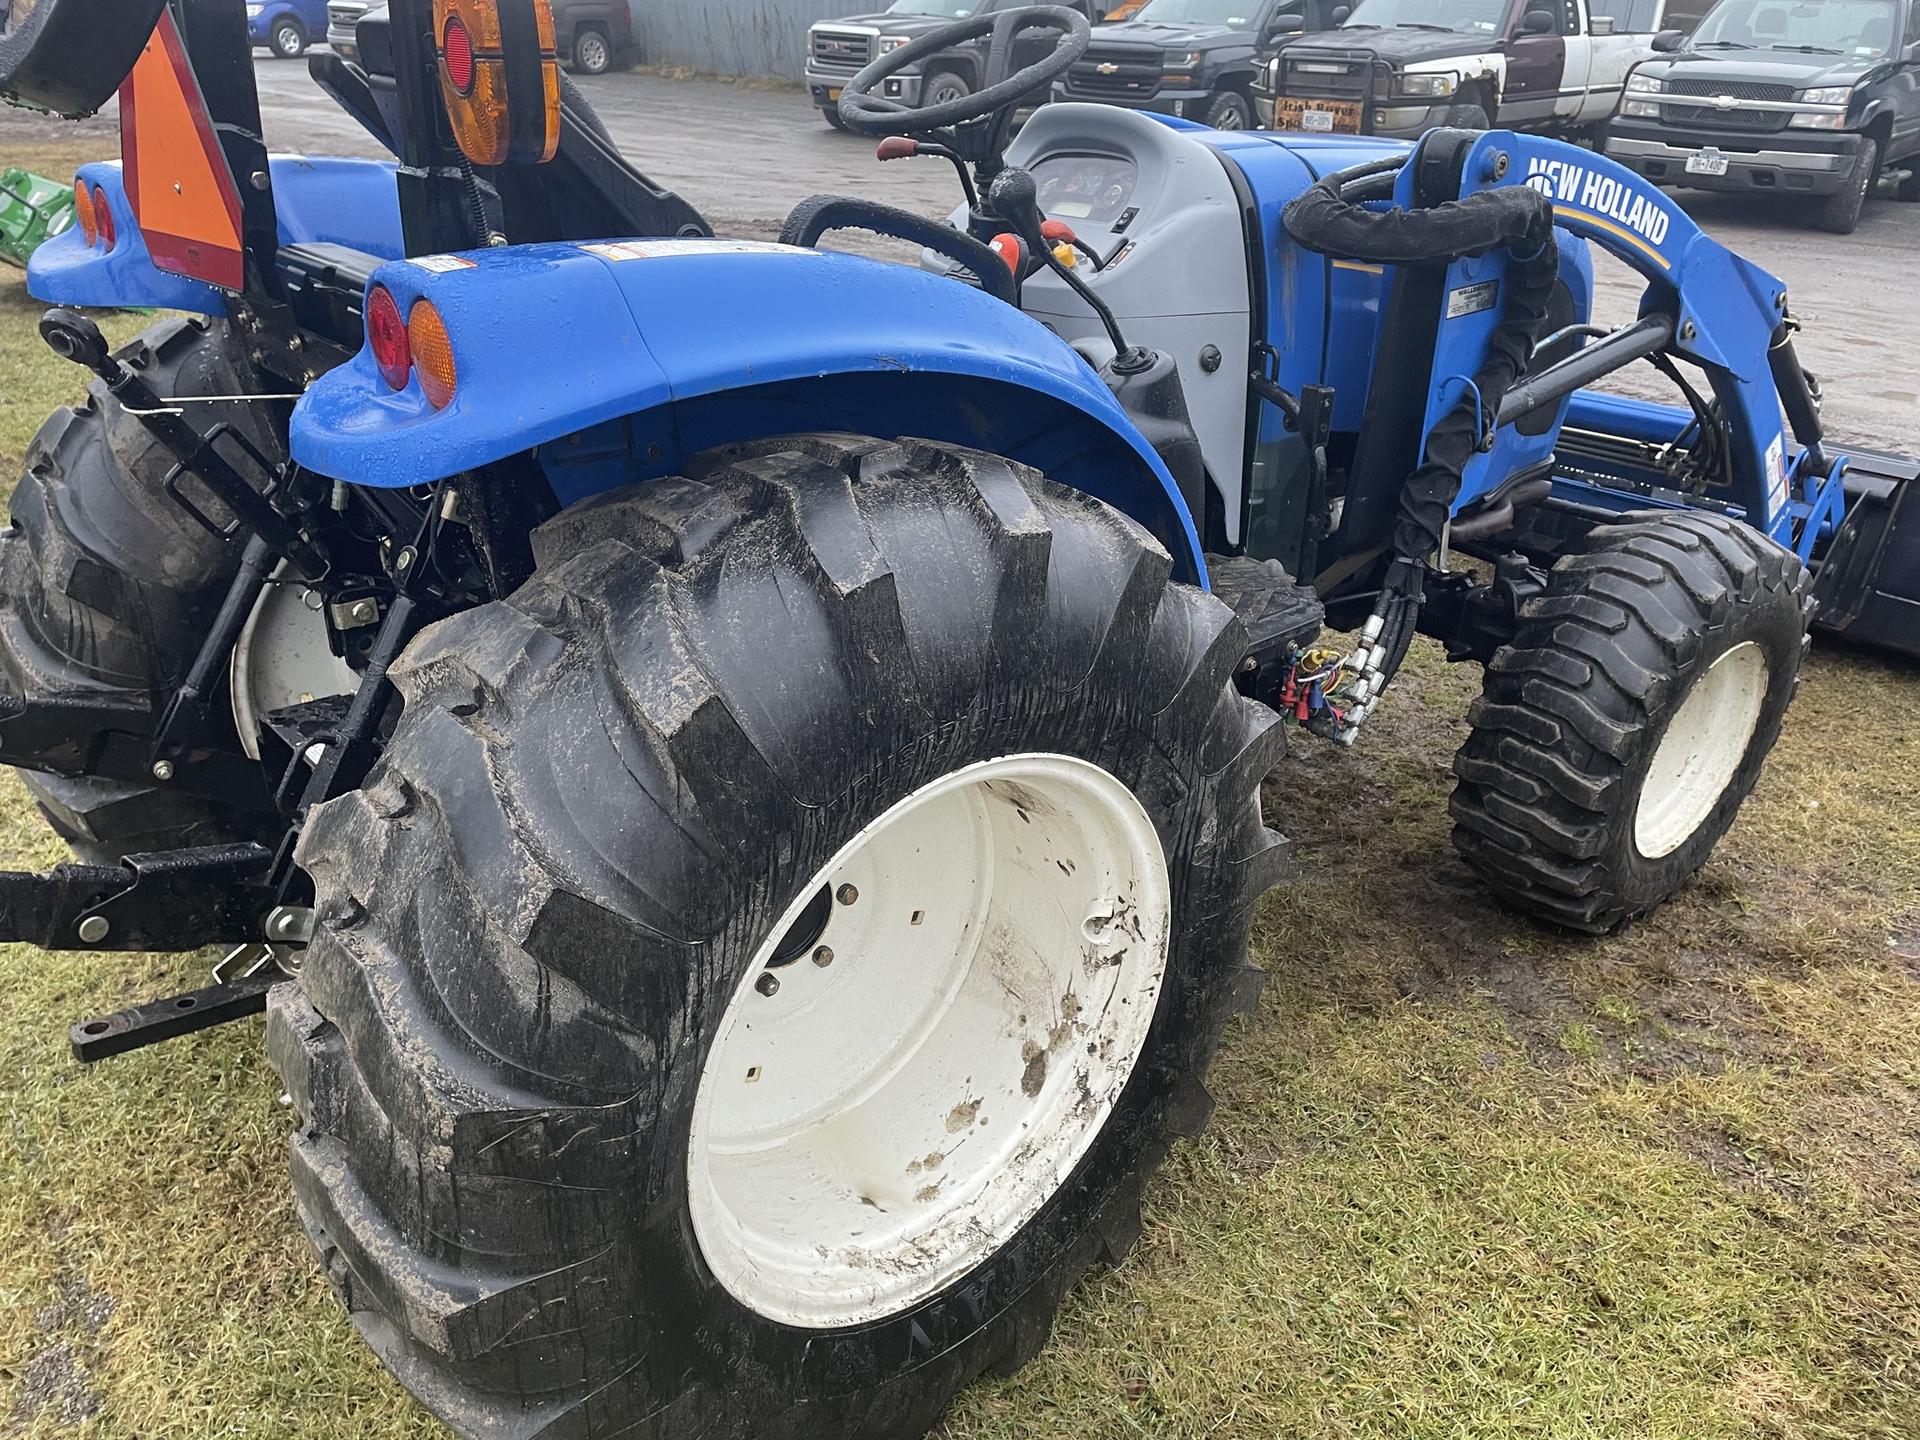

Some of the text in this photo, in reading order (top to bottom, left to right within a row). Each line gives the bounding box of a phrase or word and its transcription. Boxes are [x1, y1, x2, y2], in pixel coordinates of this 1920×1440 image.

[1284, 100, 1311, 112] Irish
[1525, 157, 1669, 246] NEW HOLLAND
